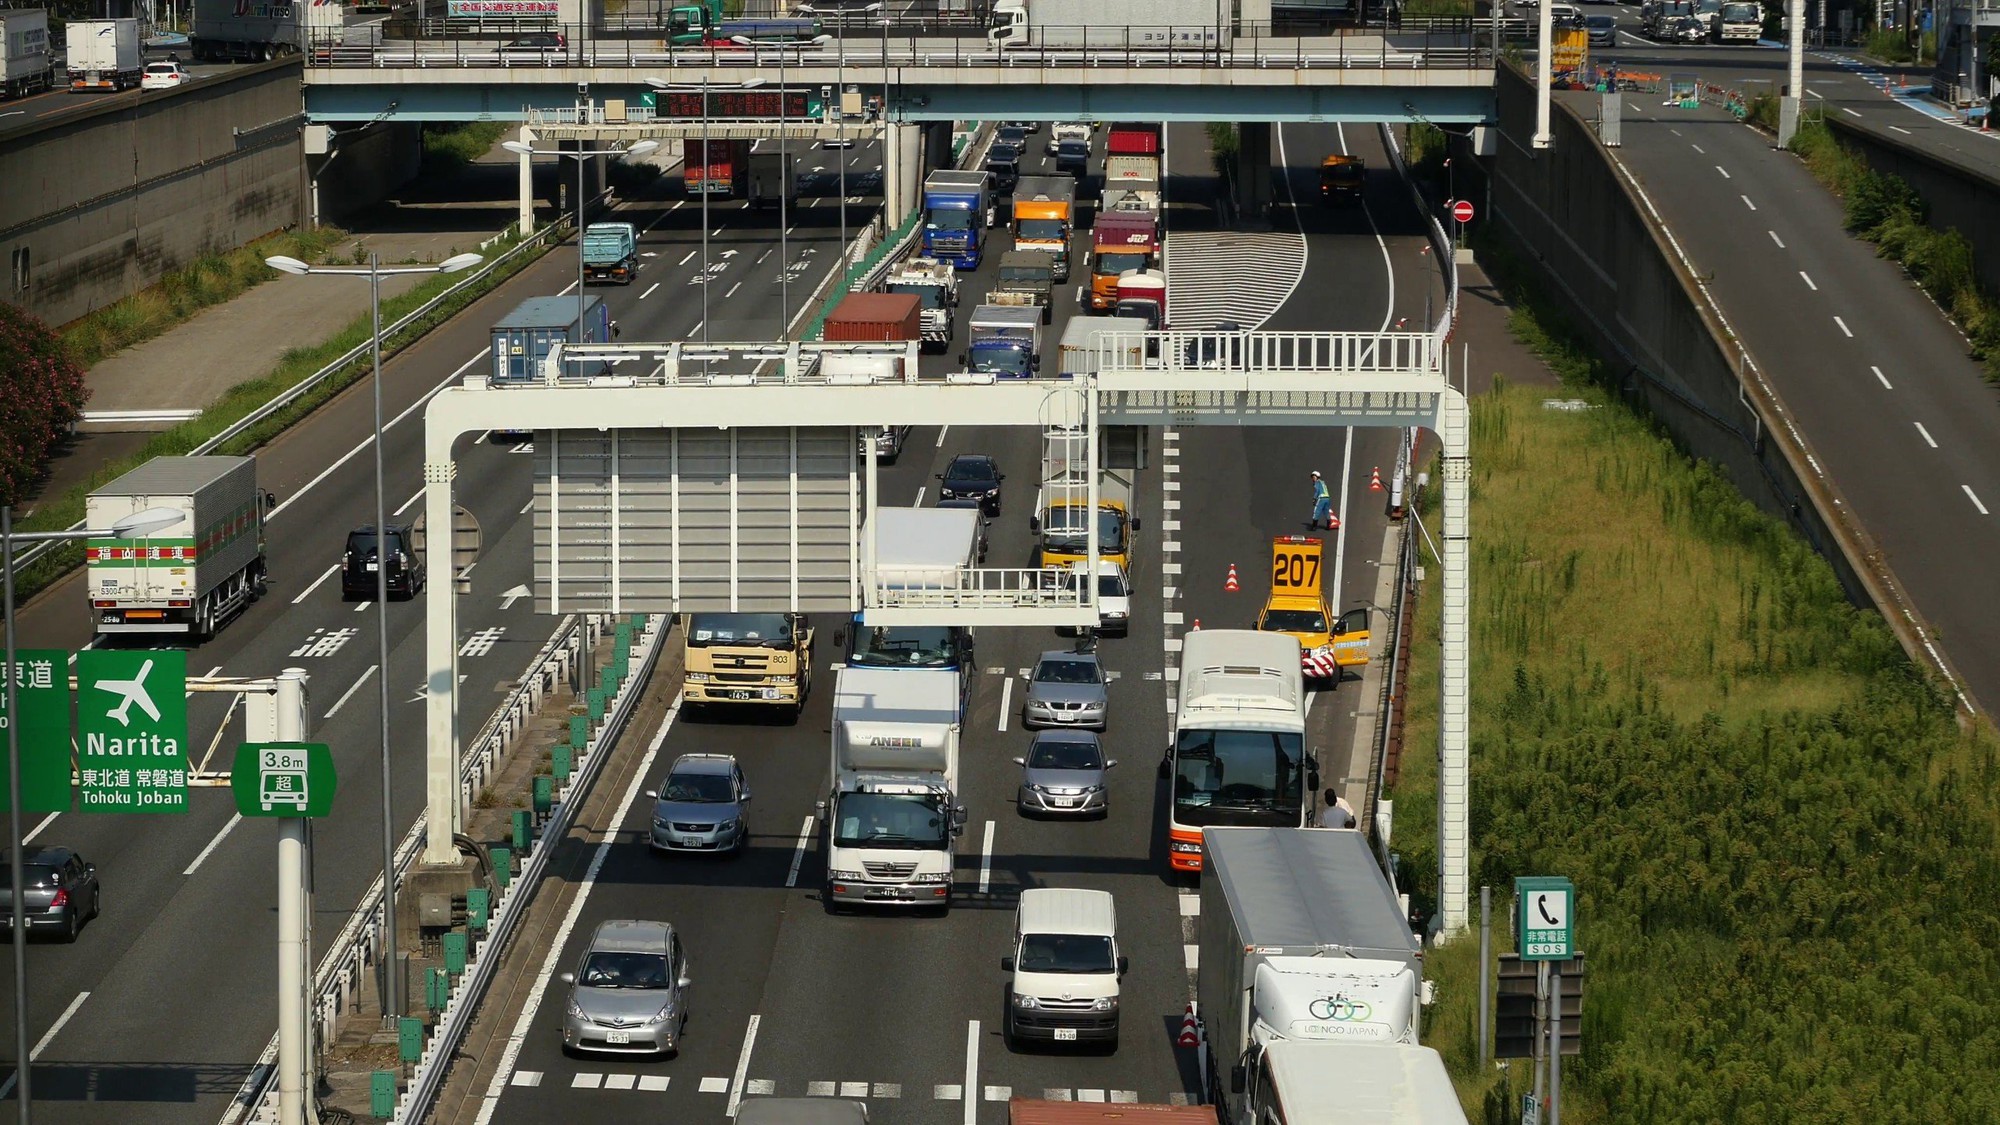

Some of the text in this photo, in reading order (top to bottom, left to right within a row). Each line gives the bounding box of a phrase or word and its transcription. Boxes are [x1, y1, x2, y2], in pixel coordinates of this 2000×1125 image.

[98, 546, 185, 561] 福山通運
[1273, 553, 1320, 588] 207
[772, 655, 788, 664] 803
[87, 731, 178, 756] Narita
[265, 752, 303, 768] 3.8m
[82, 769, 185, 787] 東北道 常磐道
[275, 775, 292, 791] 超
[82, 790, 183, 806] Tohoku Joban
[1527, 930, 1567, 942] 非常電話
[1532, 944, 1561, 954] SOS
[1346, 1026, 1379, 1036] JAPAN
